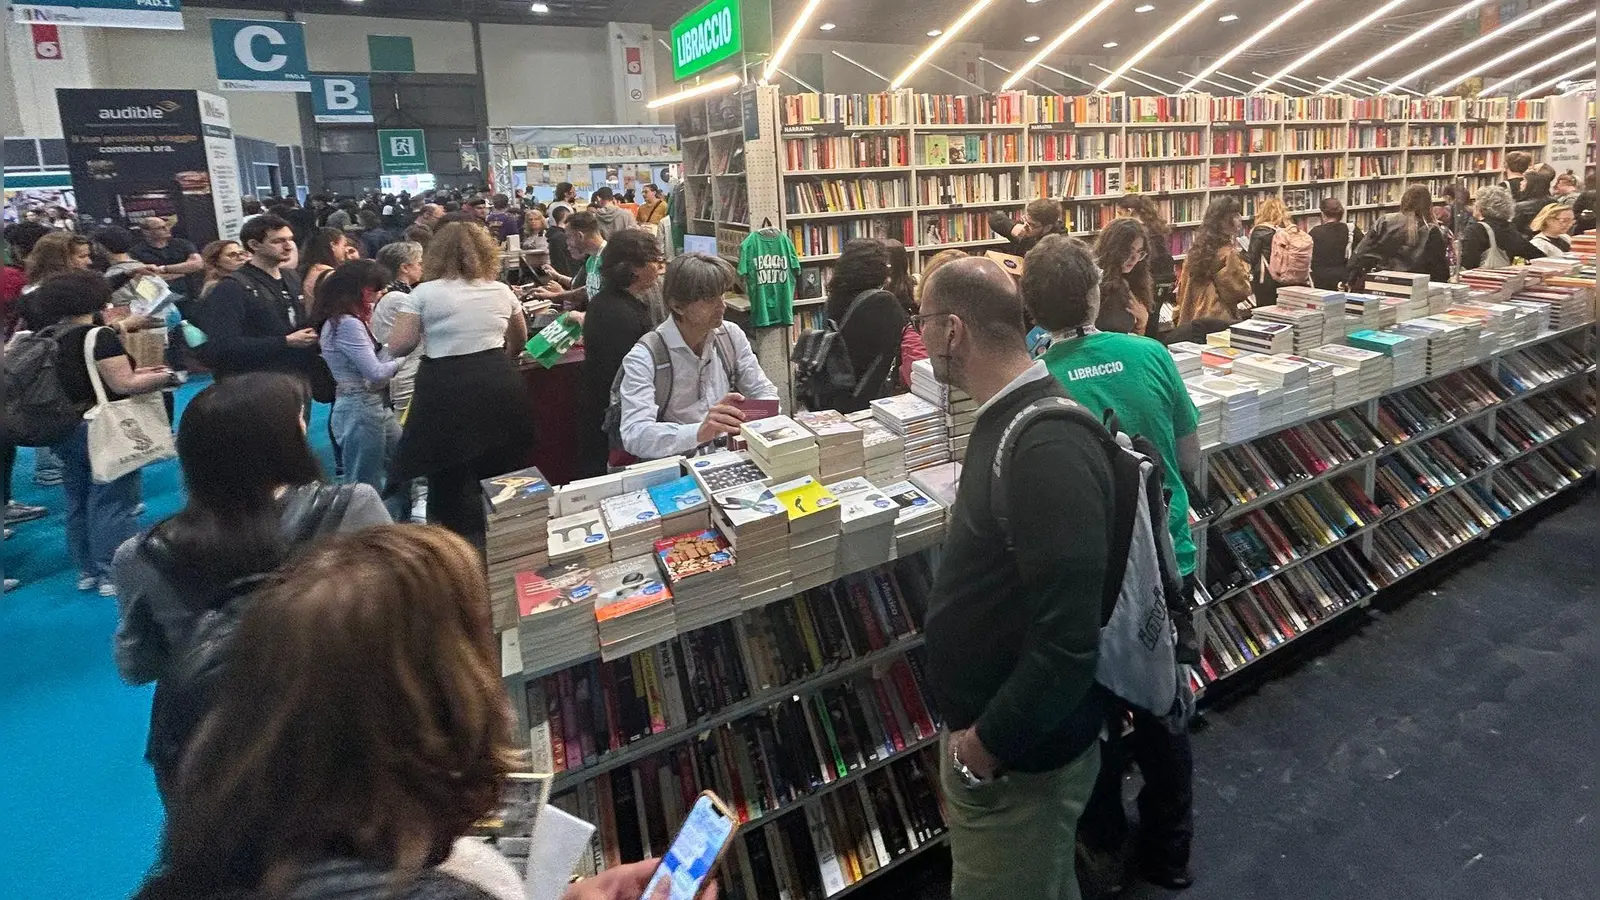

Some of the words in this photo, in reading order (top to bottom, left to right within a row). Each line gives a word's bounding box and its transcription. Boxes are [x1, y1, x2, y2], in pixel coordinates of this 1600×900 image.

[677, 6, 732, 68] LIBRACCIO
[234, 25, 287, 72] C
[324, 79, 359, 110] B
[99, 105, 164, 119] audible
[784, 125, 814, 133] NARRATIVA
[99, 144, 151, 153] comincia
[1067, 361, 1124, 381] LIBRACCIO
